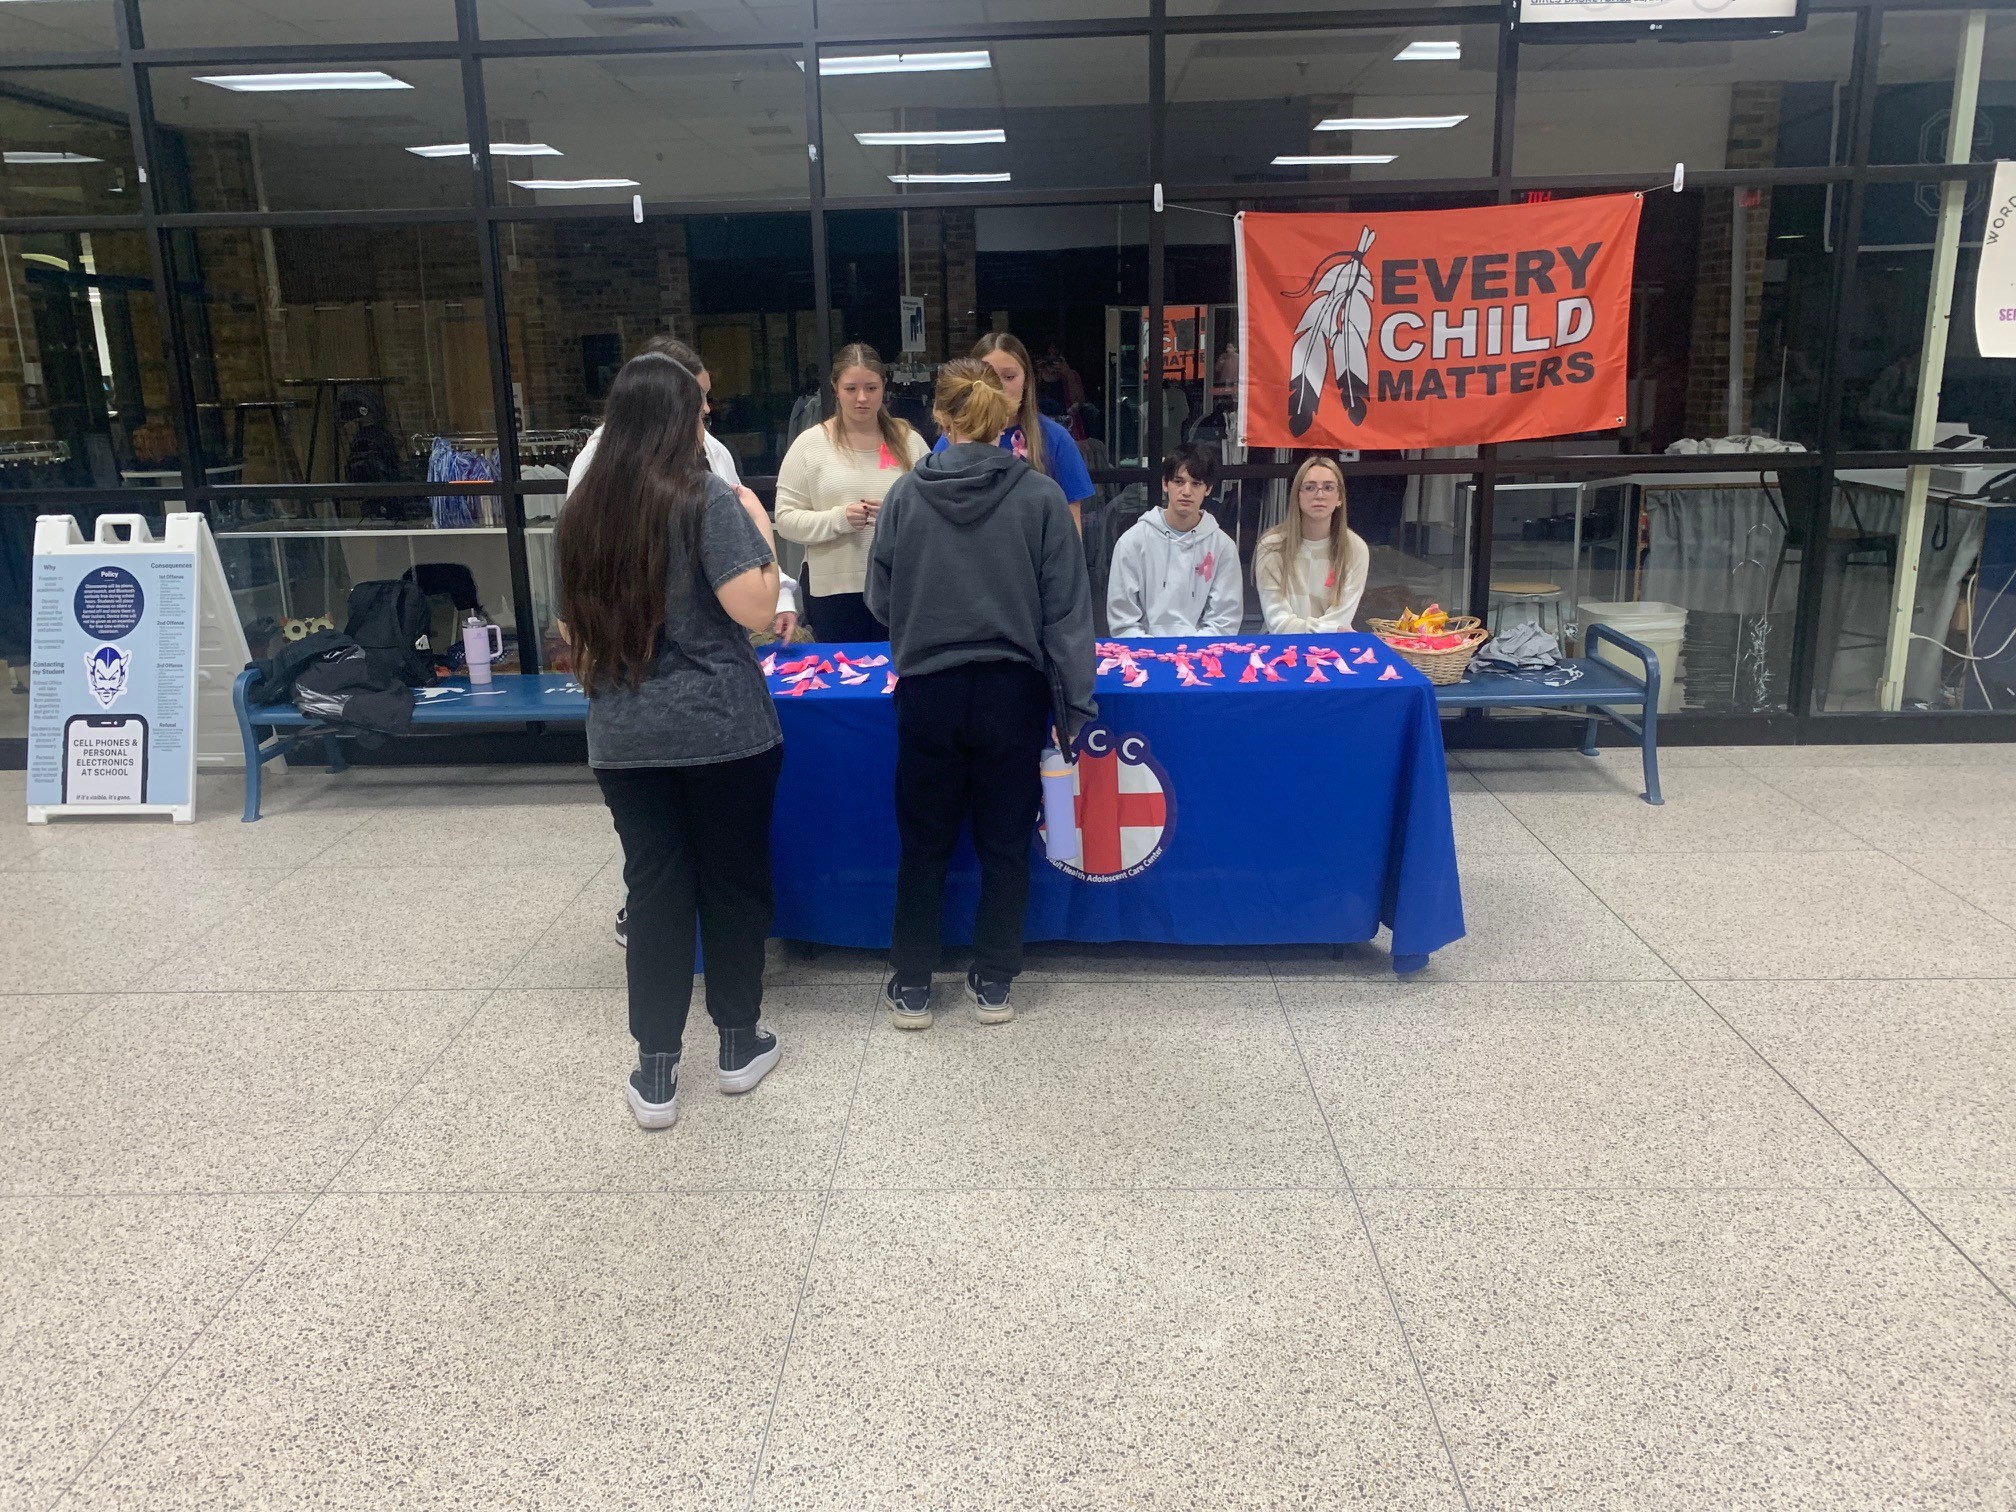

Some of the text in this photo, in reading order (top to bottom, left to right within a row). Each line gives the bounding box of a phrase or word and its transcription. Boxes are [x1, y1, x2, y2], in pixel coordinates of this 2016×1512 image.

[1381, 241, 1603, 305] EVERY
[1379, 296, 1595, 362] CHILD
[1378, 351, 1596, 402] MATTERS
[1062, 865, 1086, 880] Health
[1086, 871, 1127, 882] Adolescent
[1128, 865, 1144, 876] Care
[1143, 846, 1162, 867] Center
